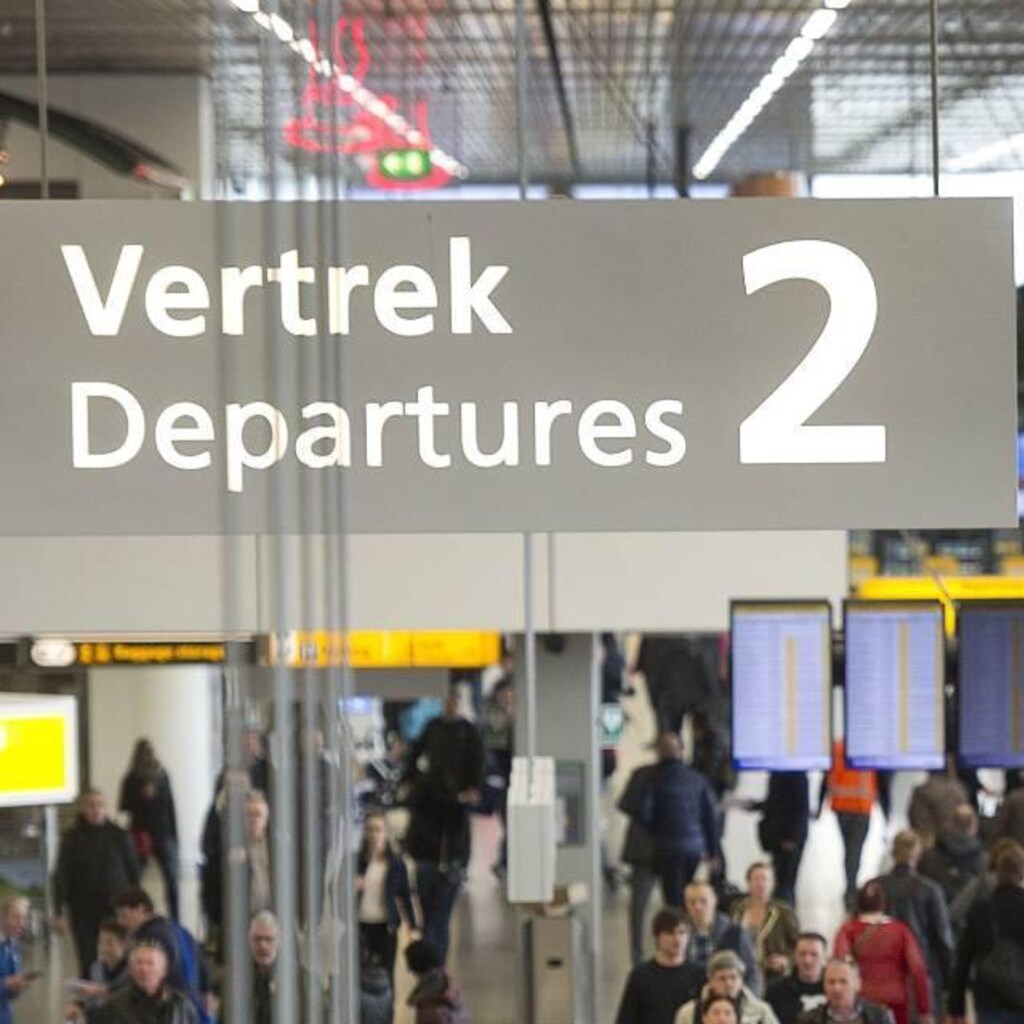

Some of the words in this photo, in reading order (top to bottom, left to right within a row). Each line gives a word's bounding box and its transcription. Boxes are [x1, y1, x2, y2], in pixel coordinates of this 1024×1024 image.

[61, 236, 514, 337] Vertrek
[739, 239, 887, 464] 2
[70, 381, 687, 493] Departures
